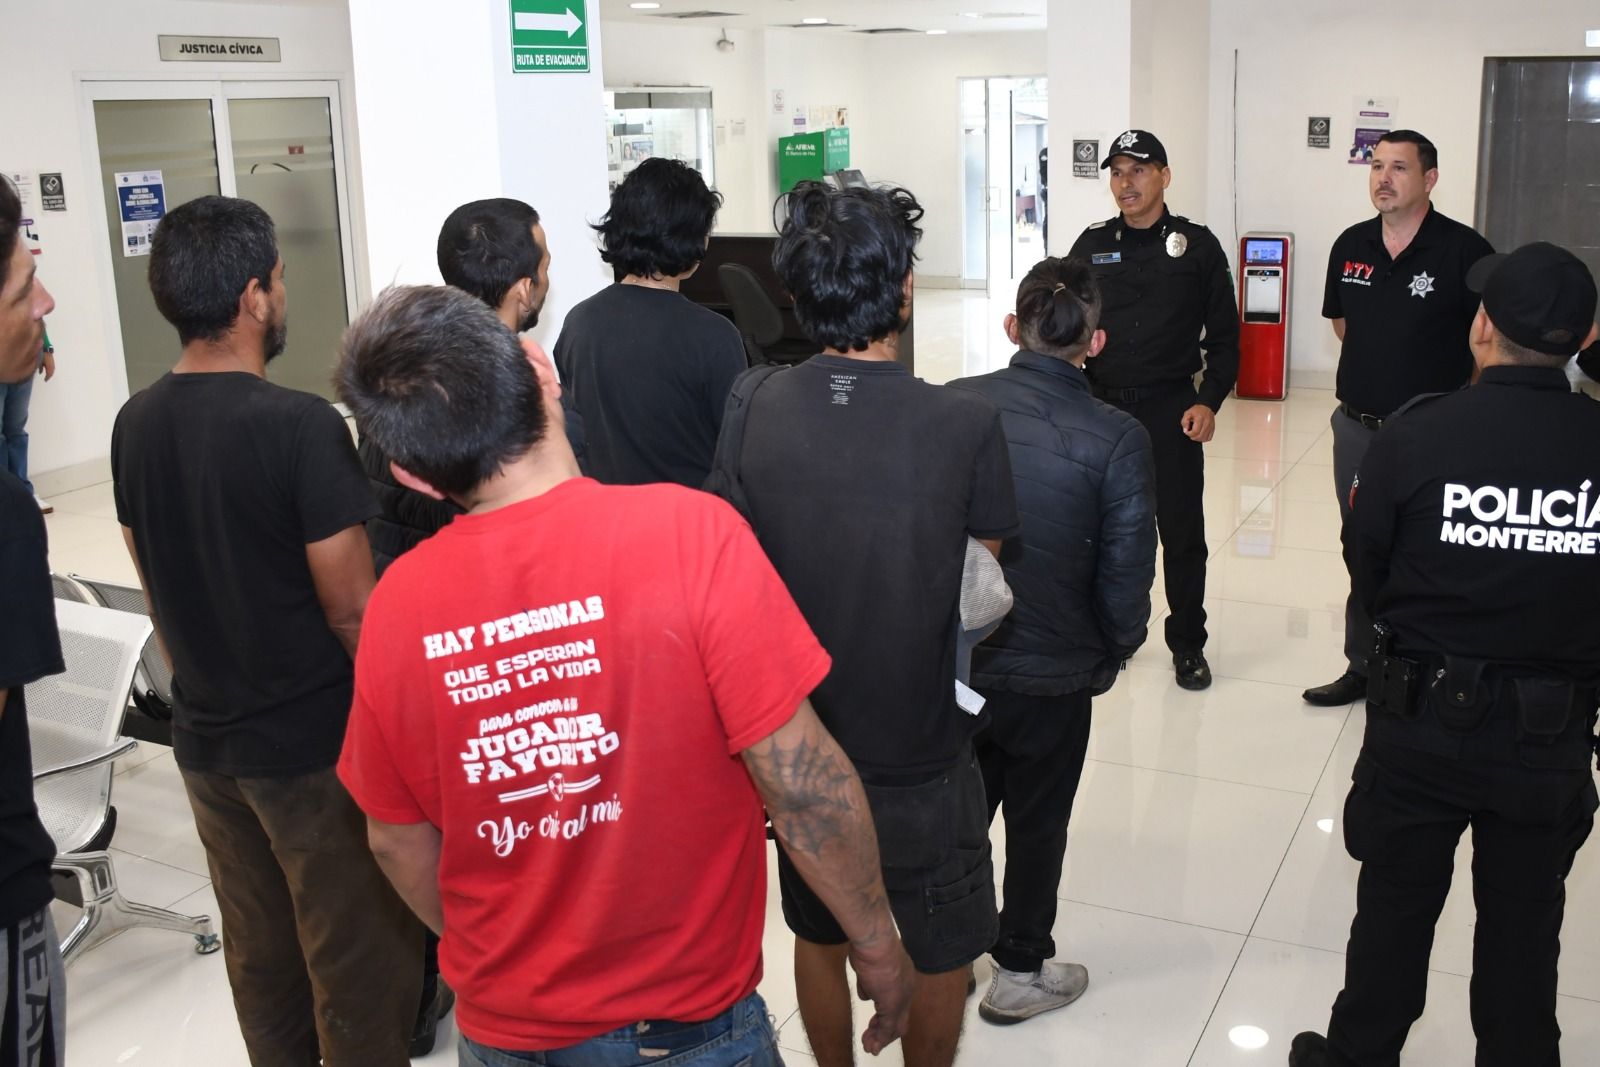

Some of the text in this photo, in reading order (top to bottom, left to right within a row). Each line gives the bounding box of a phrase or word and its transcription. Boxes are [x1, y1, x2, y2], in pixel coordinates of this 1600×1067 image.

[179, 43, 263, 55] JUSTICIA CÍVICA
[516, 52, 586, 66] RUTA DE EVACUACIÓN
[1440, 520, 1600, 555] MONTERRE
[423, 595, 605, 660] HAY PERSONAS
[444, 638, 596, 688] QUE ESPERAN
[448, 657, 602, 705] TODA LA VIDA
[460, 712, 606, 762] JUGADOR
[479, 713, 513, 737] para
[463, 731, 621, 784] FAVORITO
[477, 815, 534, 858] Yo
[562, 804, 588, 840] al
